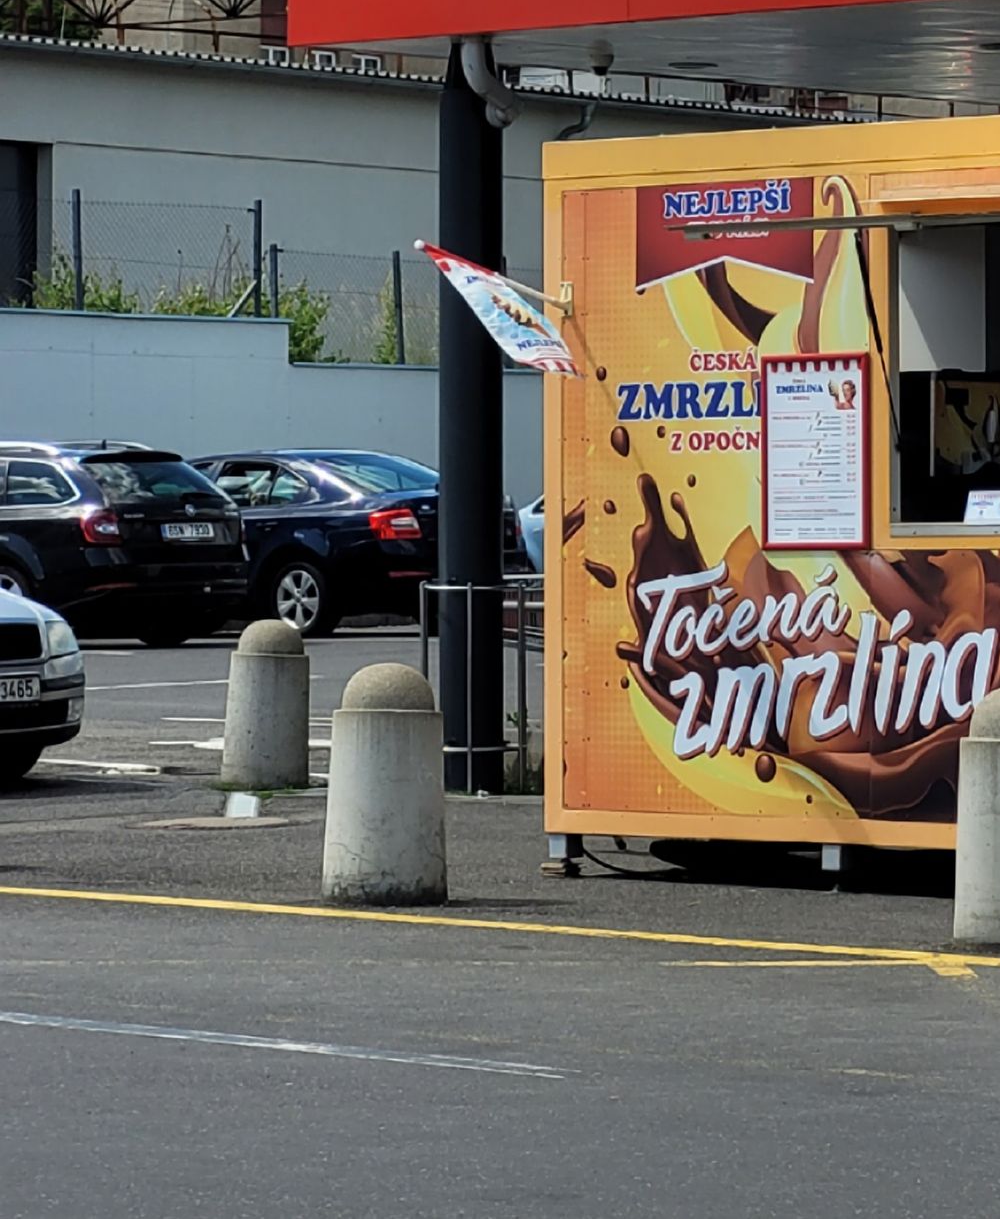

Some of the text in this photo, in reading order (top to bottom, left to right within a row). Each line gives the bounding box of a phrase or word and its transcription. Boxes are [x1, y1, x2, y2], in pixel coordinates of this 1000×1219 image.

[664, 181, 791, 218] NEJLEPŠÍ
[689, 348, 758, 373] ČESKÁ
[671, 433, 683, 451] Z
[636, 560, 851, 674] Točená
[668, 610, 998, 759] zmrzlina
